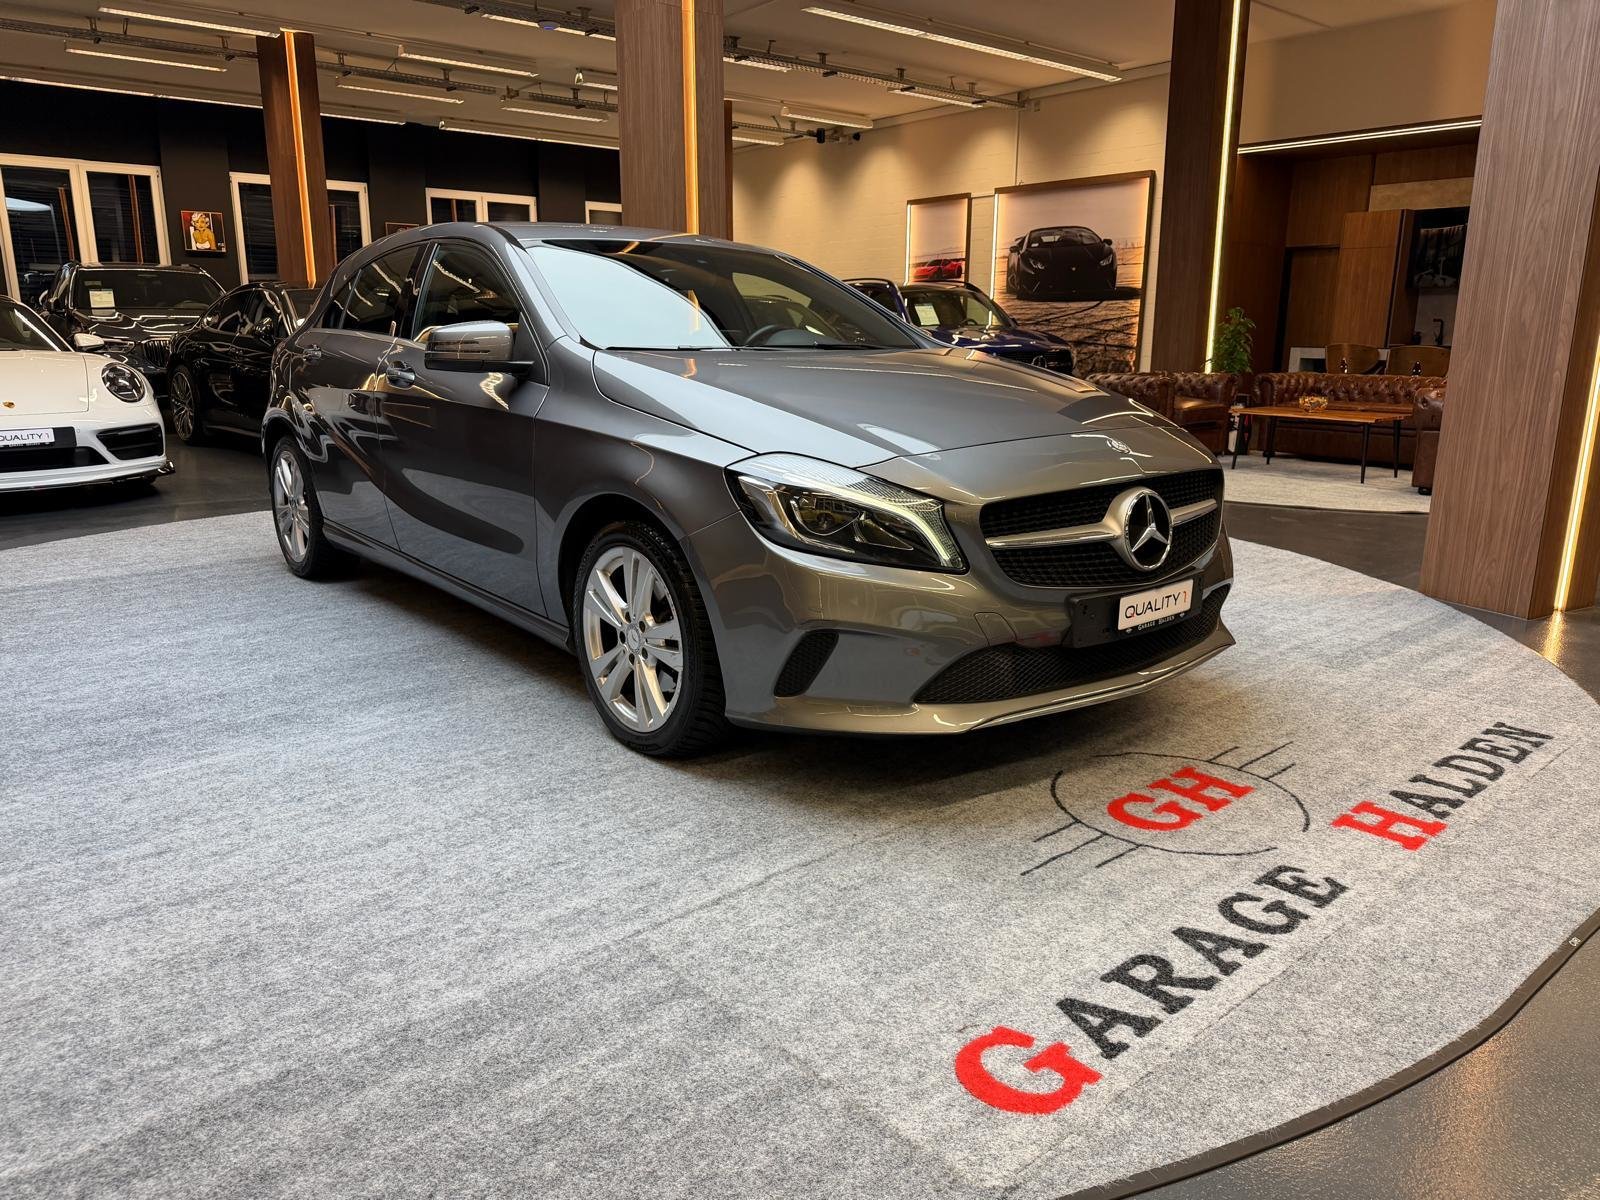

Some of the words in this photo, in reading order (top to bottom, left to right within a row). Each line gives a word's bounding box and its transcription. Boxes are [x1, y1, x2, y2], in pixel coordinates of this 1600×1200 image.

[1124, 592, 1181, 619] QUALITY
[1183, 590, 1187, 603] 1
[1106, 766, 1255, 832] GH
[954, 864, 1349, 1116] GARAGE
[1331, 721, 1554, 852] HALDEN
